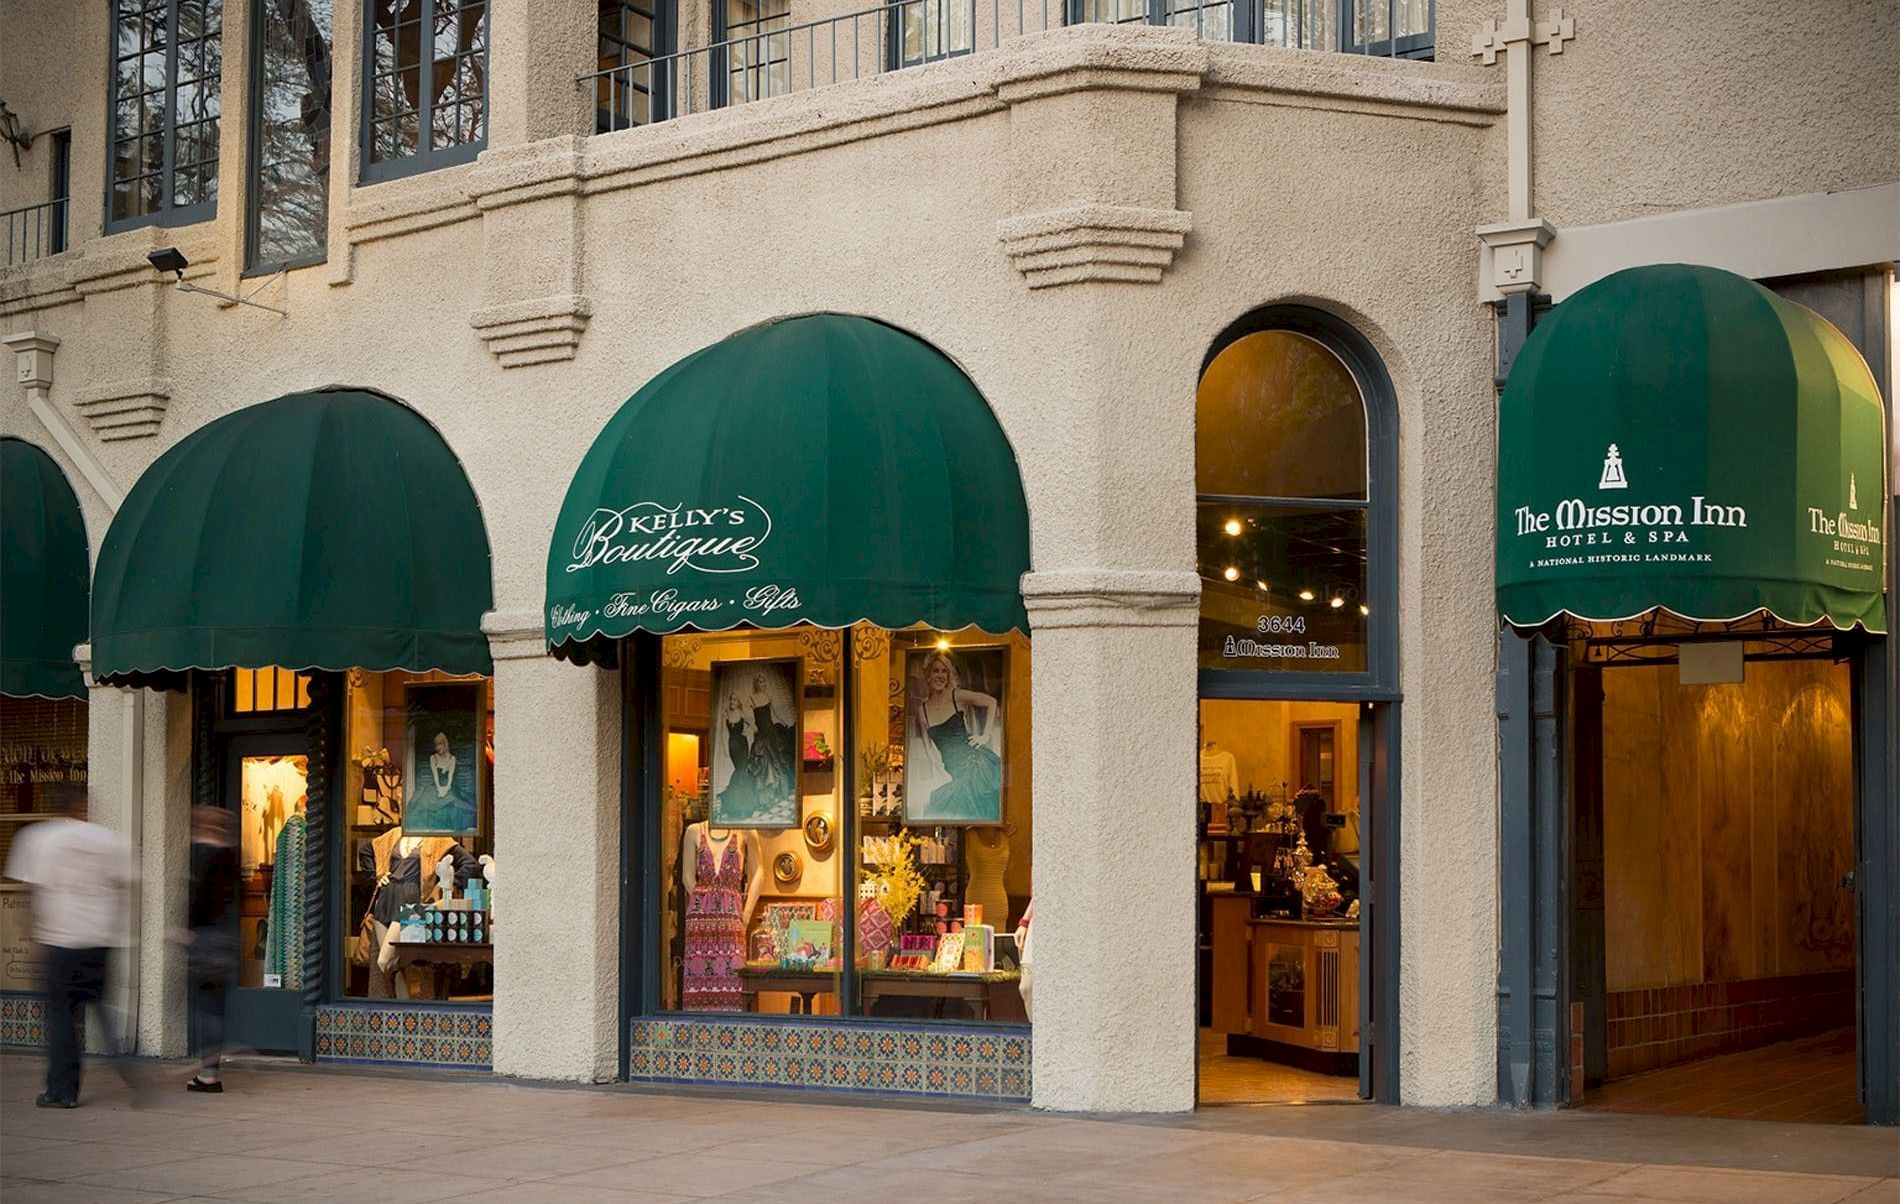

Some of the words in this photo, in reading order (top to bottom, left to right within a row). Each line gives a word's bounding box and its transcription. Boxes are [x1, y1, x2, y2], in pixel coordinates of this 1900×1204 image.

[629, 507, 745, 533] KELLY'S
[1515, 505, 1551, 536] The
[1555, 498, 1684, 530] Mission
[1690, 496, 1747, 527] Inn
[1808, 507, 1836, 536] The
[565, 501, 770, 574] Boutique
[1545, 532, 1612, 548] HOTEL
[1623, 531, 1637, 544] &
[1648, 530, 1689, 543] SPA
[1529, 560, 1535, 569] A
[1537, 556, 1585, 568] NATIONAL
[1587, 554, 1641, 563] HISTORIC
[1645, 553, 1713, 562] LANDMARK
[603, 591, 649, 618] Fine
[650, 588, 723, 622] Cigars
[743, 584, 802, 617] Gifts
[1257, 615, 1306, 634] 3644
[1237, 639, 1306, 658] Mission
[1308, 641, 1340, 659] Inn
